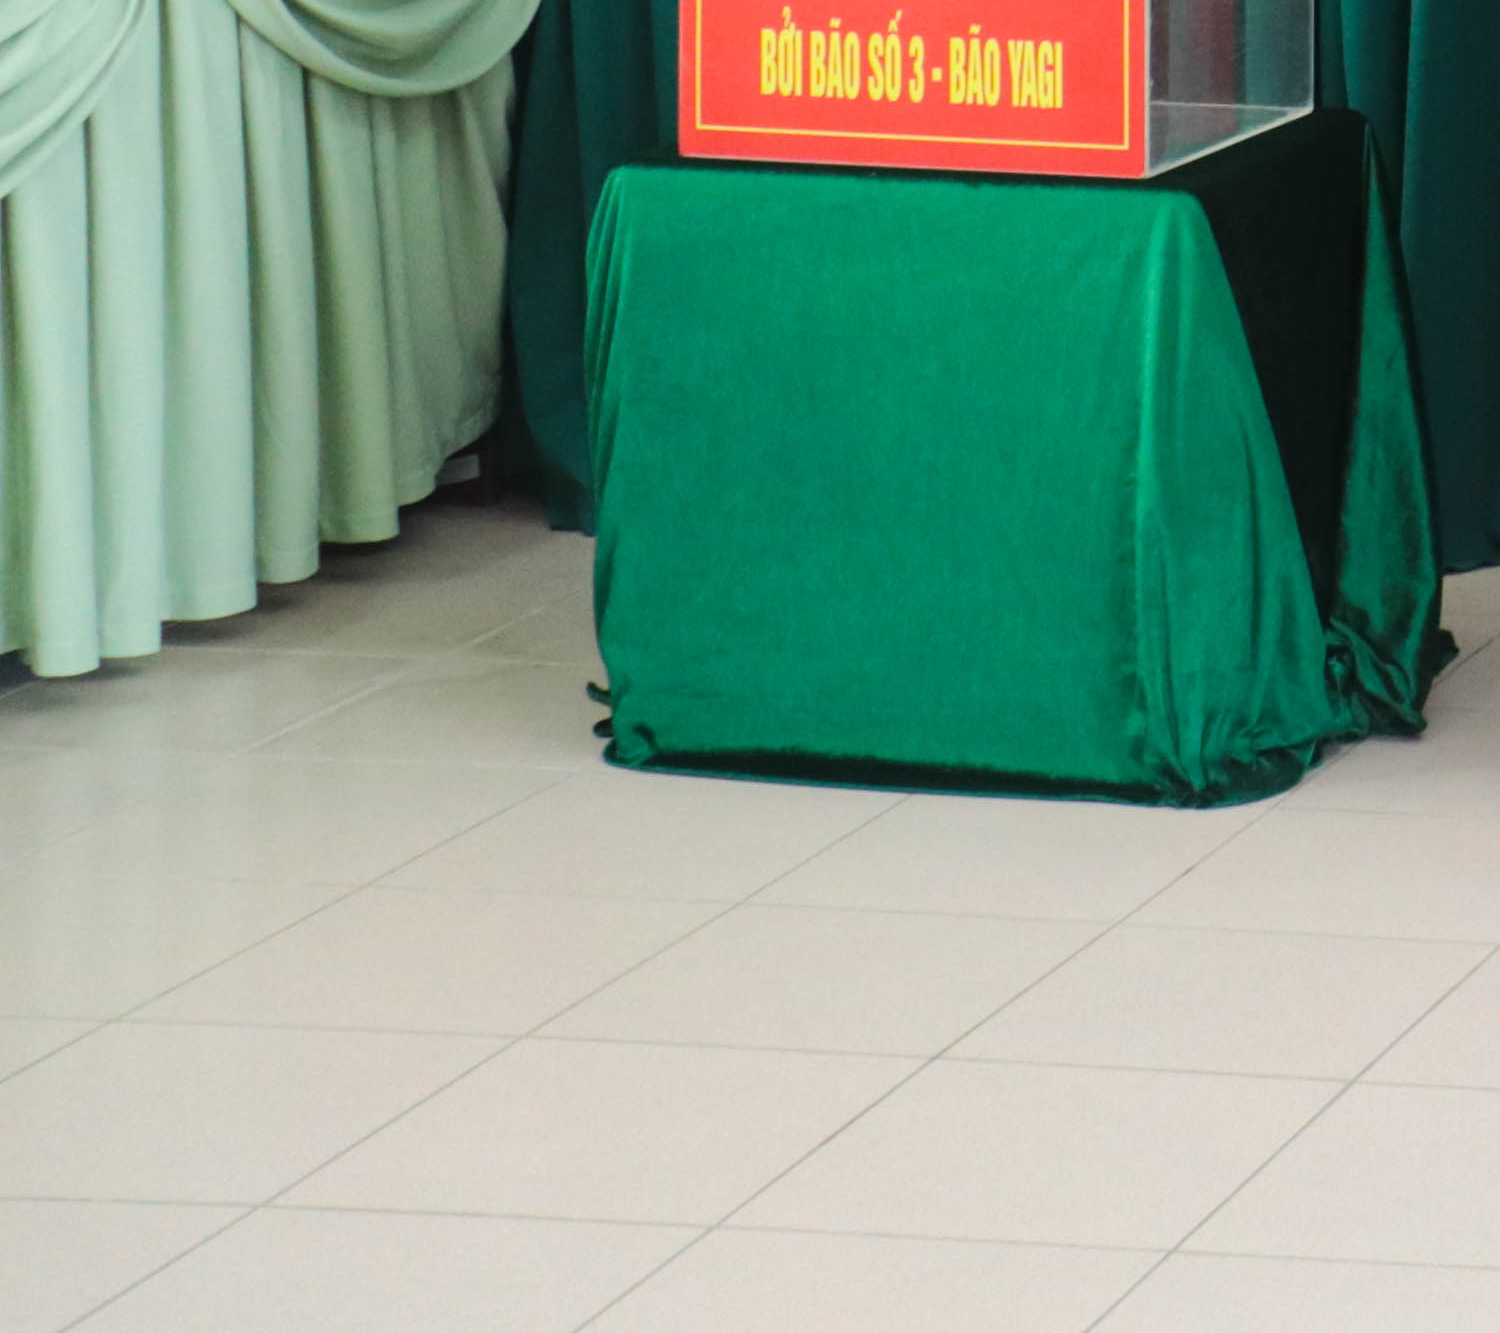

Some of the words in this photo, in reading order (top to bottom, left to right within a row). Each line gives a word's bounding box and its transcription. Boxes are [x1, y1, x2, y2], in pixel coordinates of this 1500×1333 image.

[760, 7, 802, 97] BỞI
[810, 16, 860, 101] BÃO
[867, 10, 903, 102] SỐ
[908, 36, 924, 103] 3
[949, 23, 1000, 107] BÃO
[1007, 39, 1064, 109] YAGI
